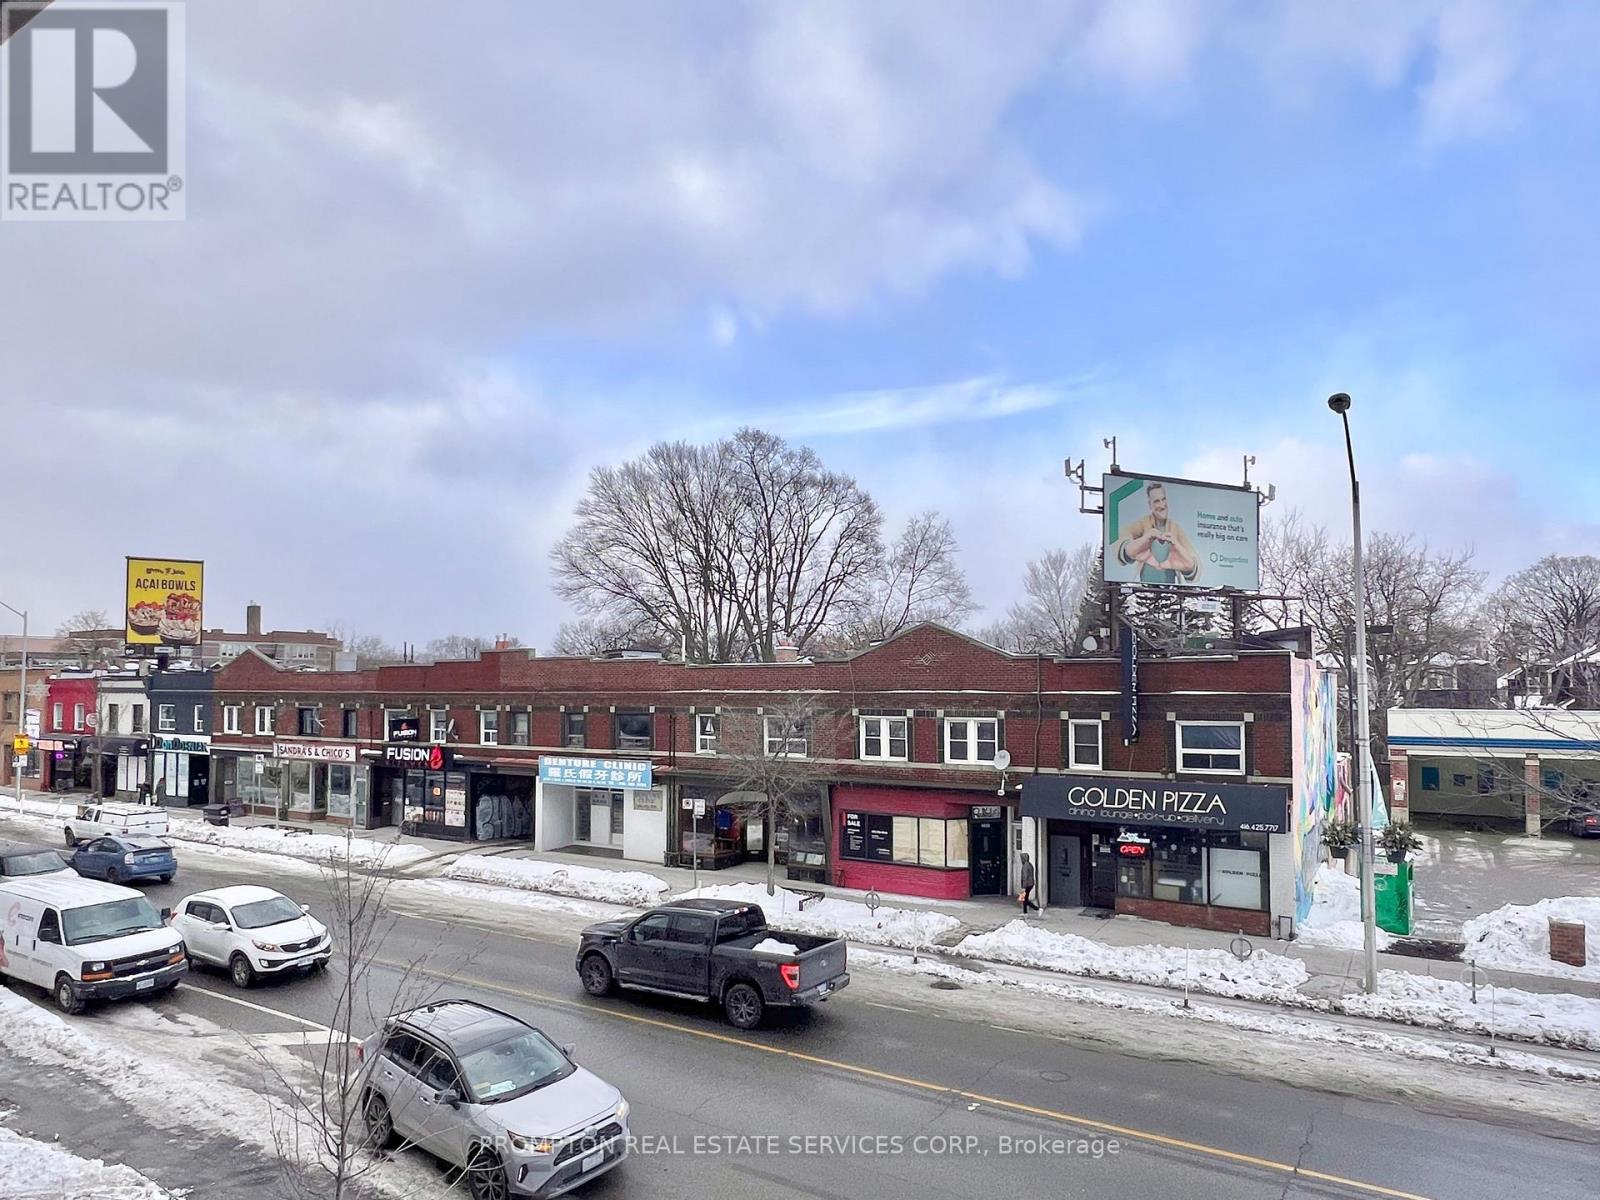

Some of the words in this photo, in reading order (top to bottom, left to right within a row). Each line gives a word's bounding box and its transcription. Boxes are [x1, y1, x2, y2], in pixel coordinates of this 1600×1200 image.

[1197, 511, 1216, 520] Home
[1197, 521, 1227, 531] insurance
[1228, 525, 1245, 533] that's
[1197, 531, 1215, 540] really
[1216, 532, 1225, 541] big
[135, 578, 159, 592] AÇAI
[161, 579, 196, 591] BOWLS
[393, 729, 417, 737] FUSION
[280, 745, 312, 757] SANDRA'S
[314, 747, 320, 757] &
[321, 748, 350, 759] CHICO'S
[387, 748, 429, 760] FUSION
[544, 757, 597, 768] DENTURE
[1068, 786, 1156, 810] GOLDEN
[1162, 790, 1227, 814] PIZZA
[1120, 845, 1145, 855] OPEN
